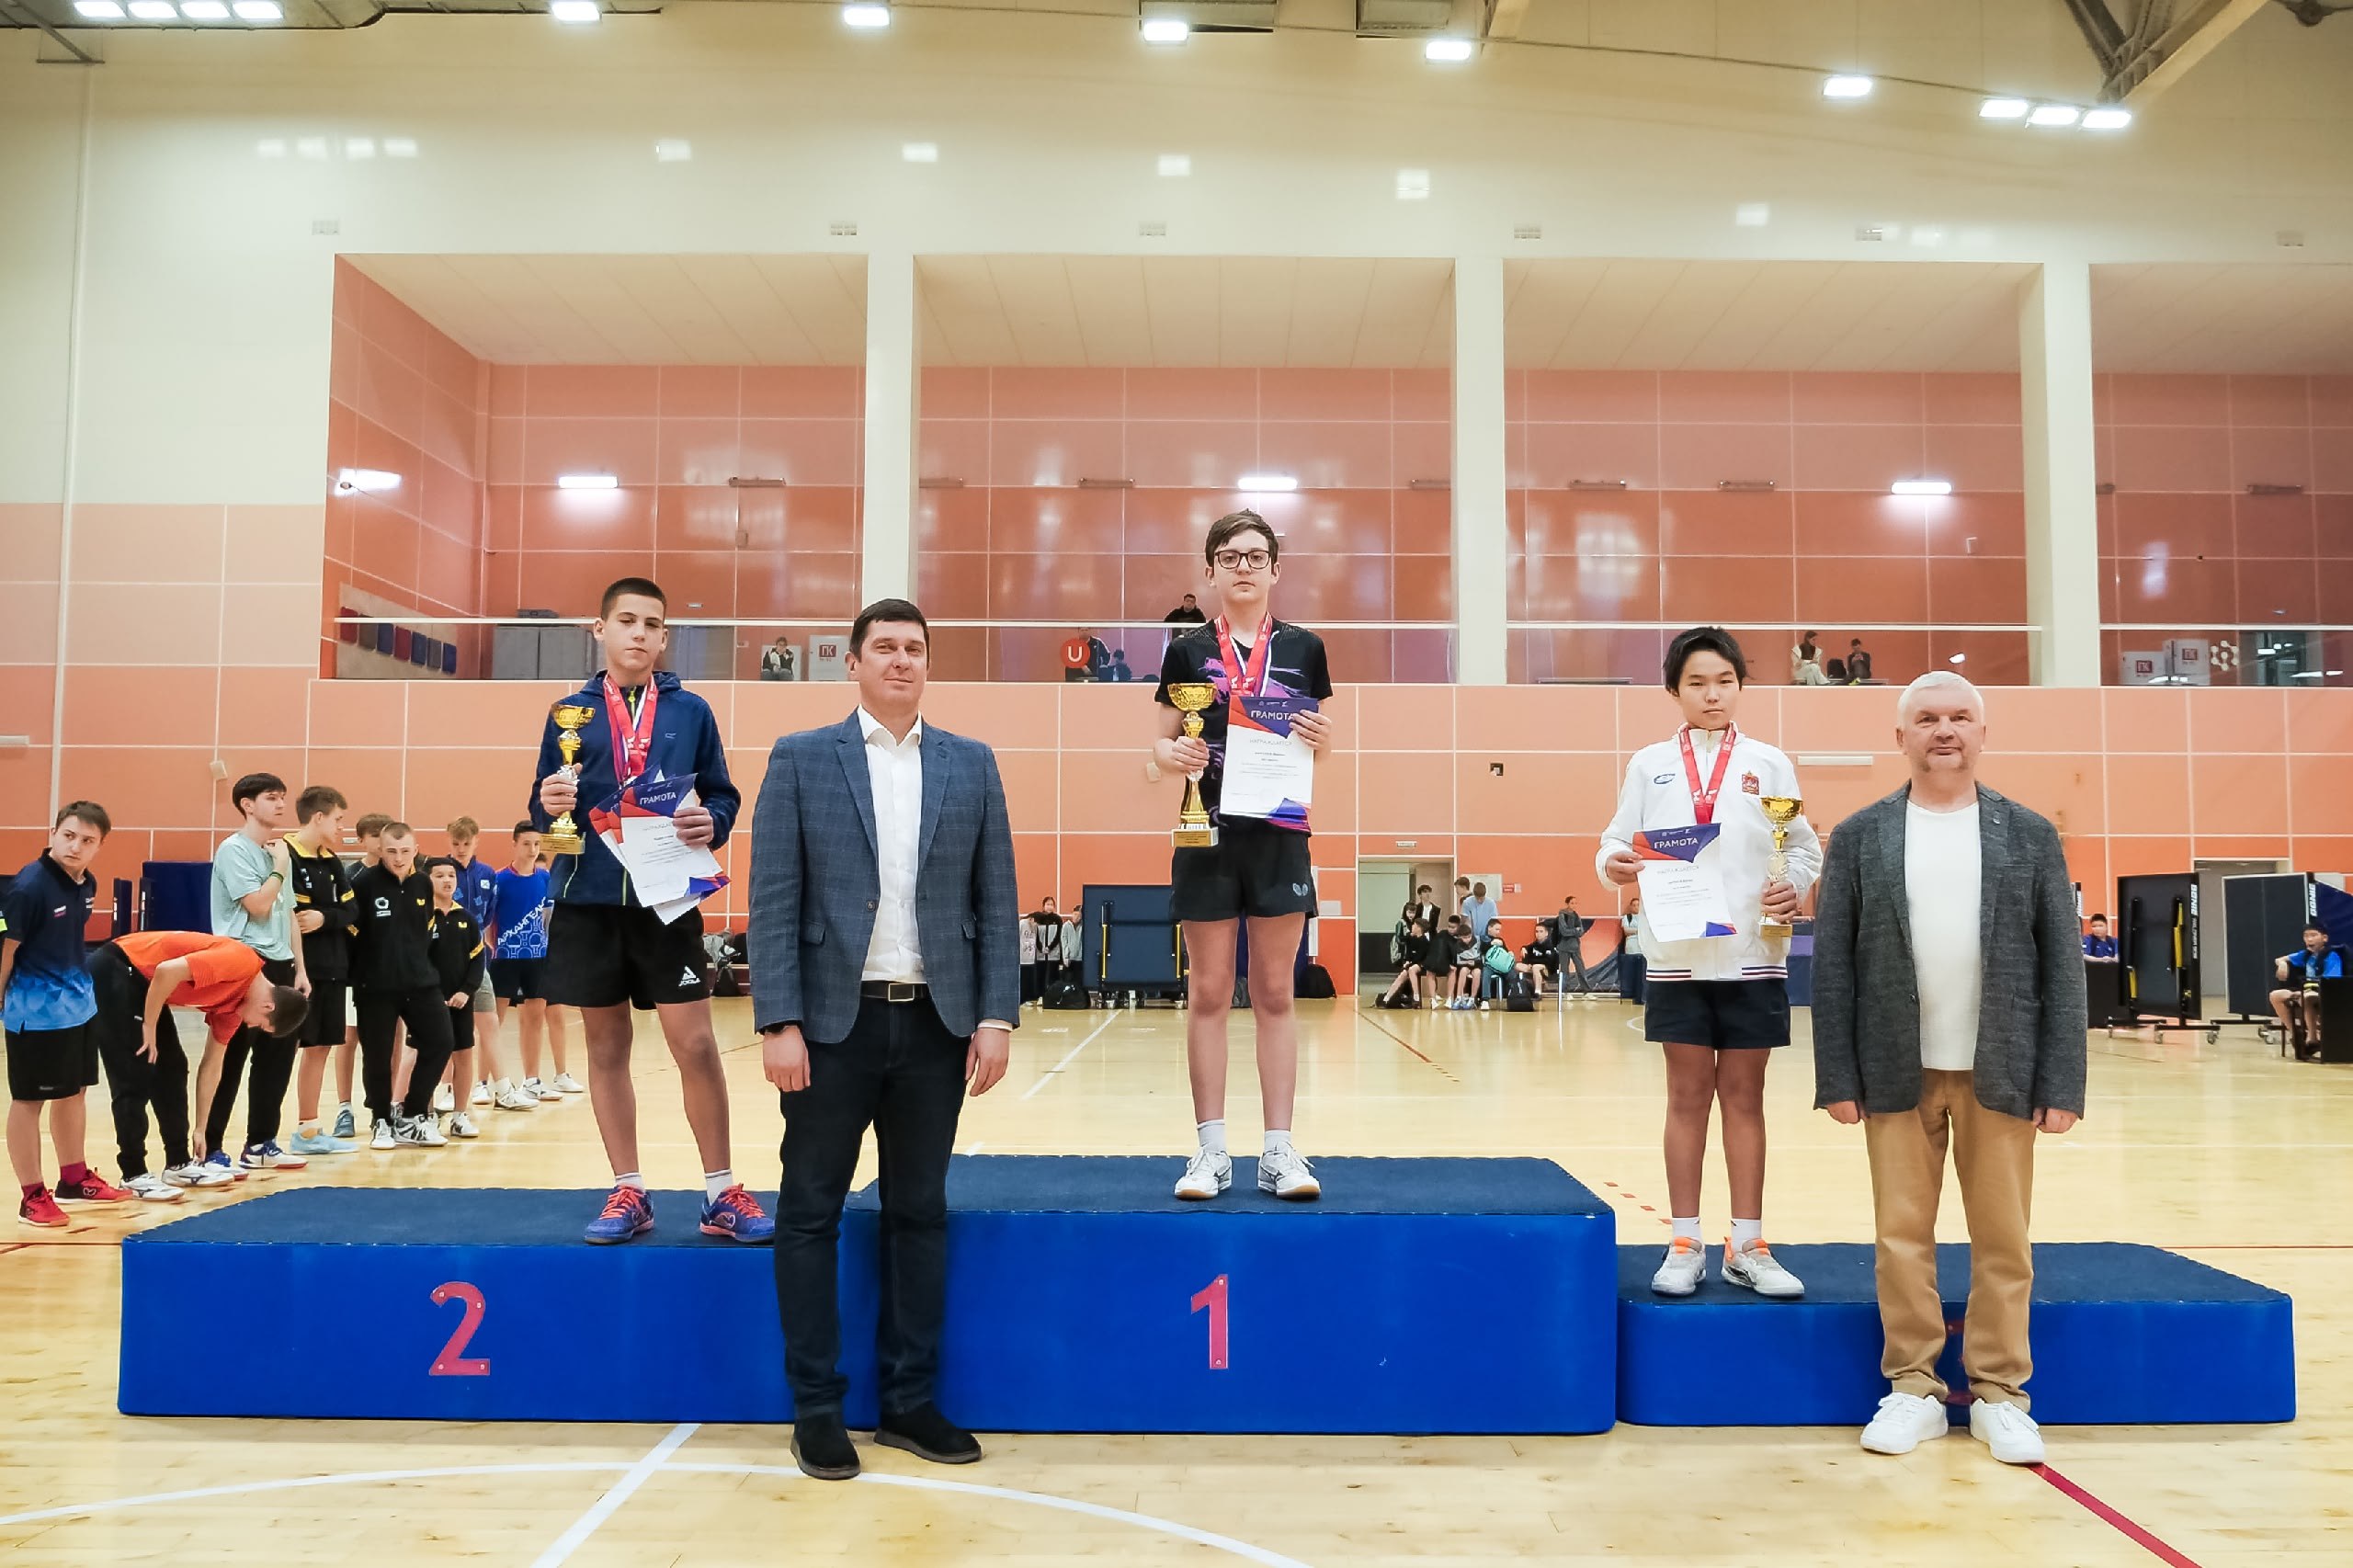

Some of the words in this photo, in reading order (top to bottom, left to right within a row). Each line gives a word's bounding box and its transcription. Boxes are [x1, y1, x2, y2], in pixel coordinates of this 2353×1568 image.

[640, 791, 676, 805] ГРАМОТА
[1654, 837, 1699, 849] ГРАМОТА
[428, 1281, 490, 1375] 2
[1190, 1274, 1229, 1369] 1
